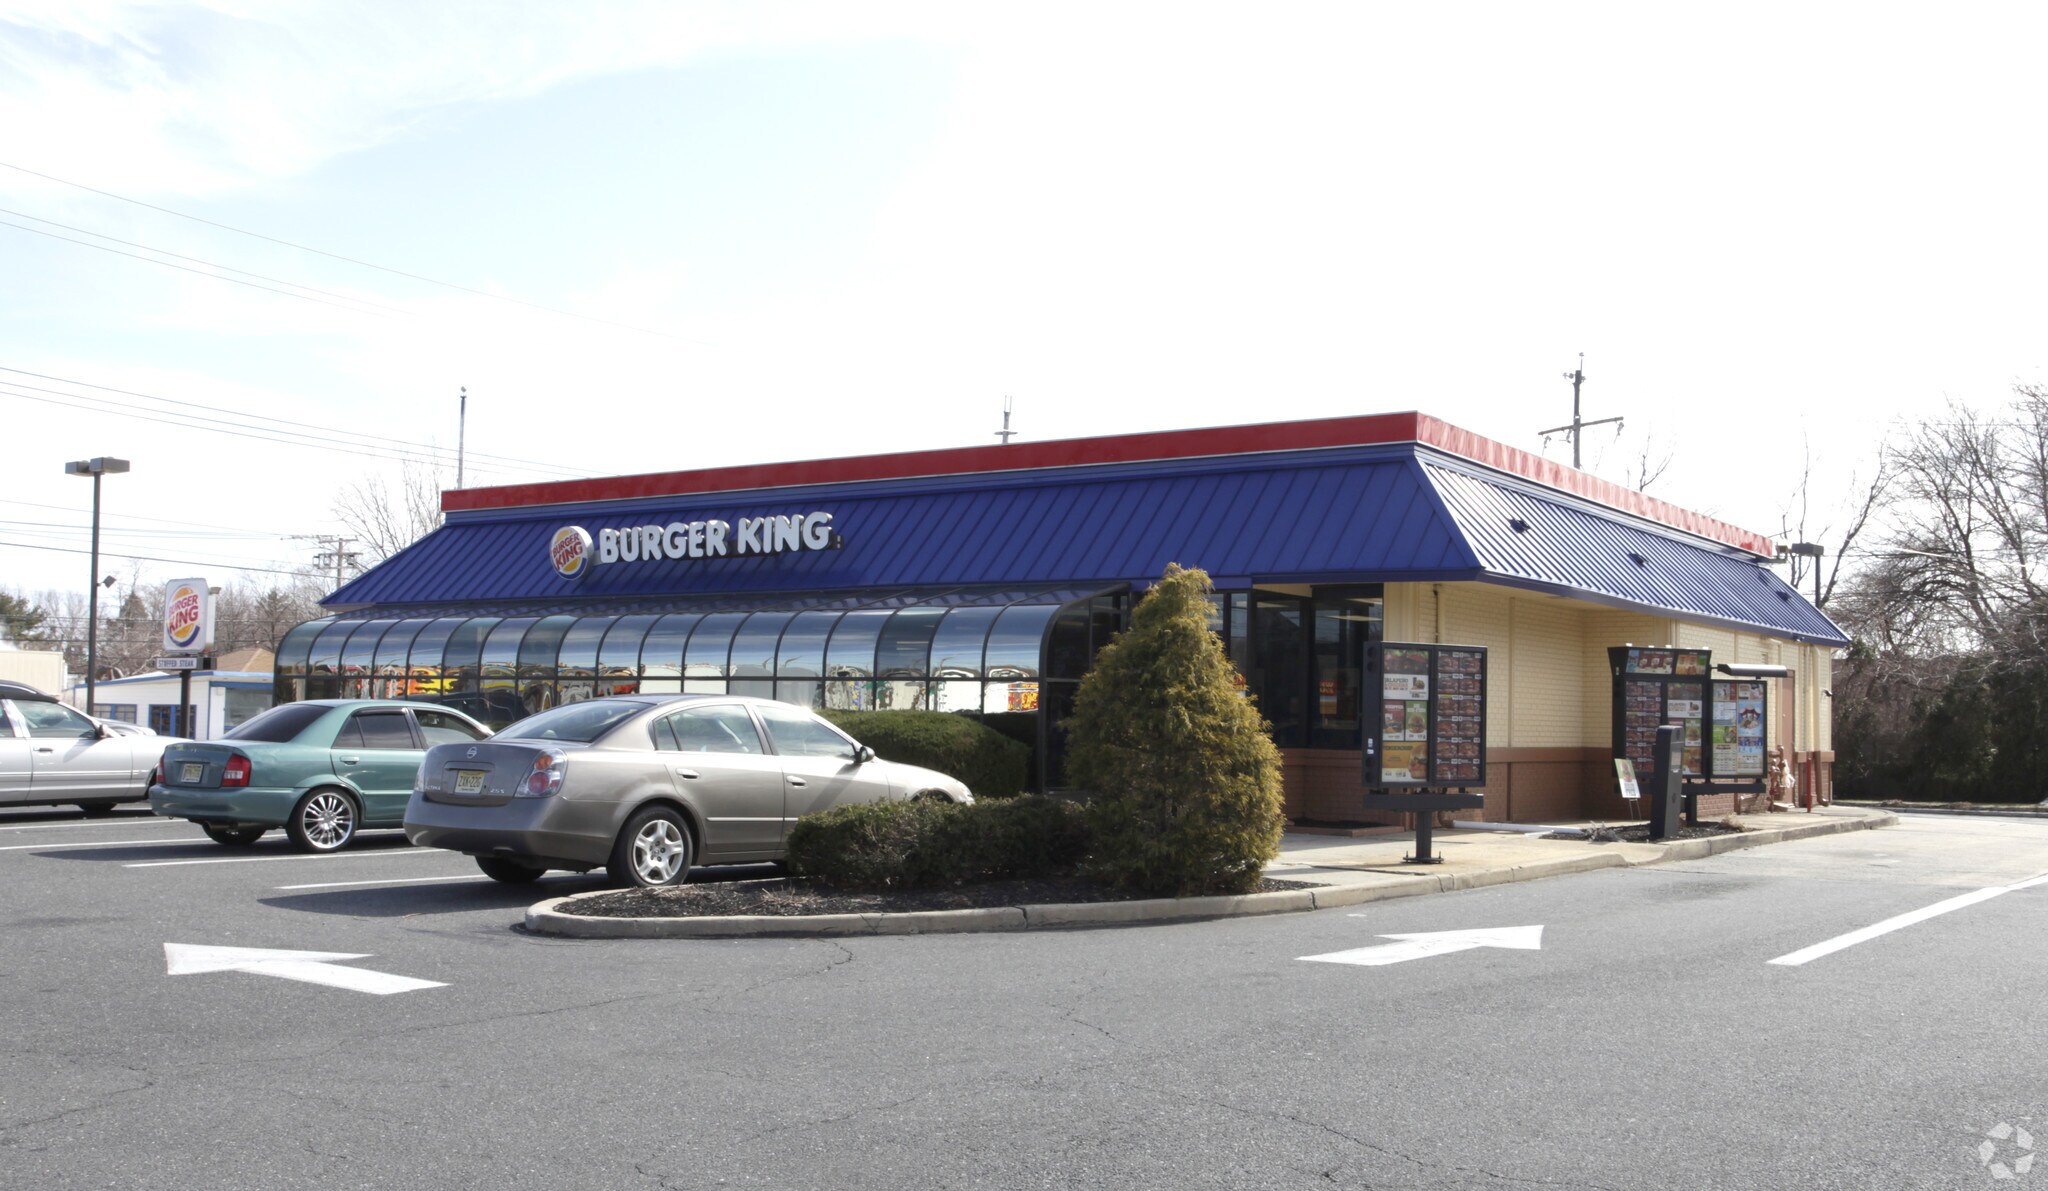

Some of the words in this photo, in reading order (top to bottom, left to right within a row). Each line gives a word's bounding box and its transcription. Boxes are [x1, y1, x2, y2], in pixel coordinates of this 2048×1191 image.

[553, 532, 580, 558] BURGER
[599, 519, 730, 564] BURGER
[738, 511, 833, 554] KING
[556, 541, 583, 571] KING
[169, 594, 199, 618] BURGER
[169, 605, 199, 634] KING
